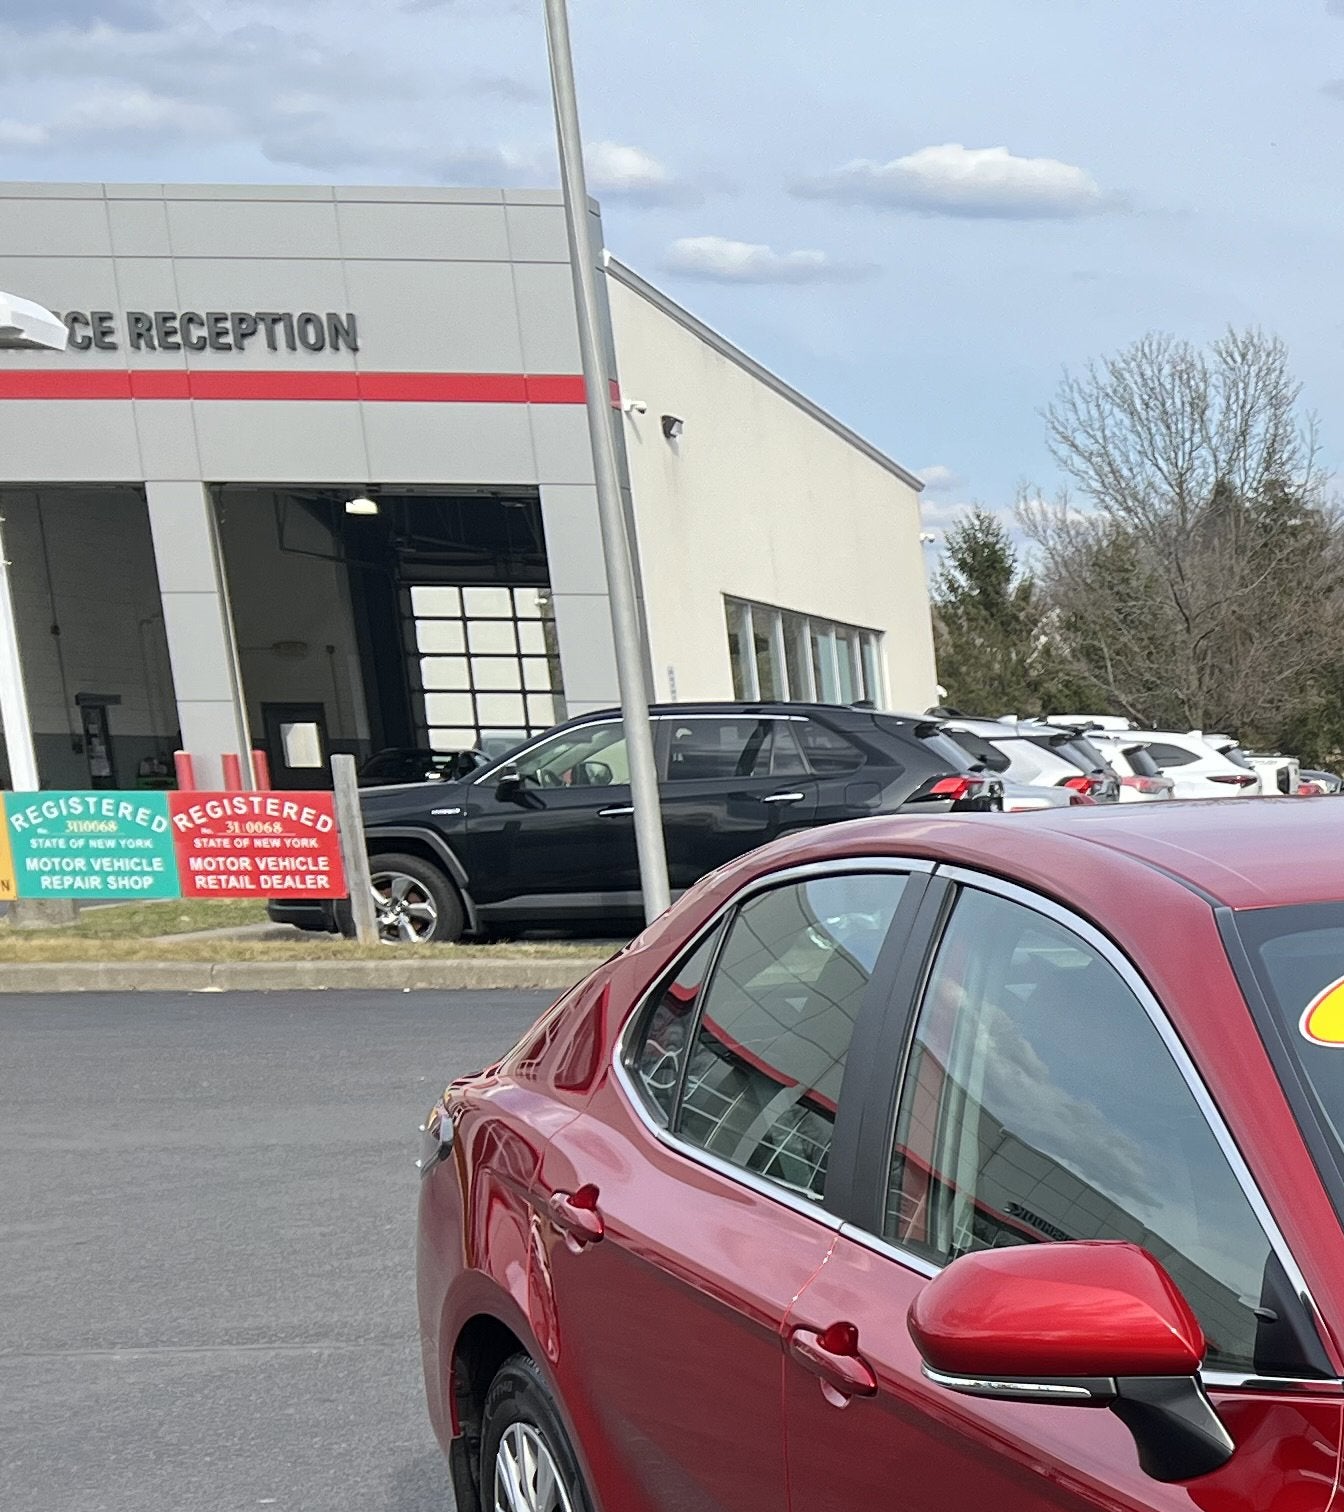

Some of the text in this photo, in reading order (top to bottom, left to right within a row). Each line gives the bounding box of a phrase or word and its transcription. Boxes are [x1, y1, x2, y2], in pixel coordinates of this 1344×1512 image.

[126, 311, 359, 352] RECEPTION
[10, 797, 168, 833] REGISTERED
[173, 797, 333, 833] REGISTERED
[29, 838, 153, 849] STATE OF NEW YORK
[193, 837, 319, 849] STATE OF NEW YORK
[25, 857, 164, 872] MOTOR VEHICLE
[188, 856, 330, 872] MOTOR VEHICLE
[40, 875, 154, 890] REPAIR SHOP
[194, 875, 330, 890] RETAIL DEALER
